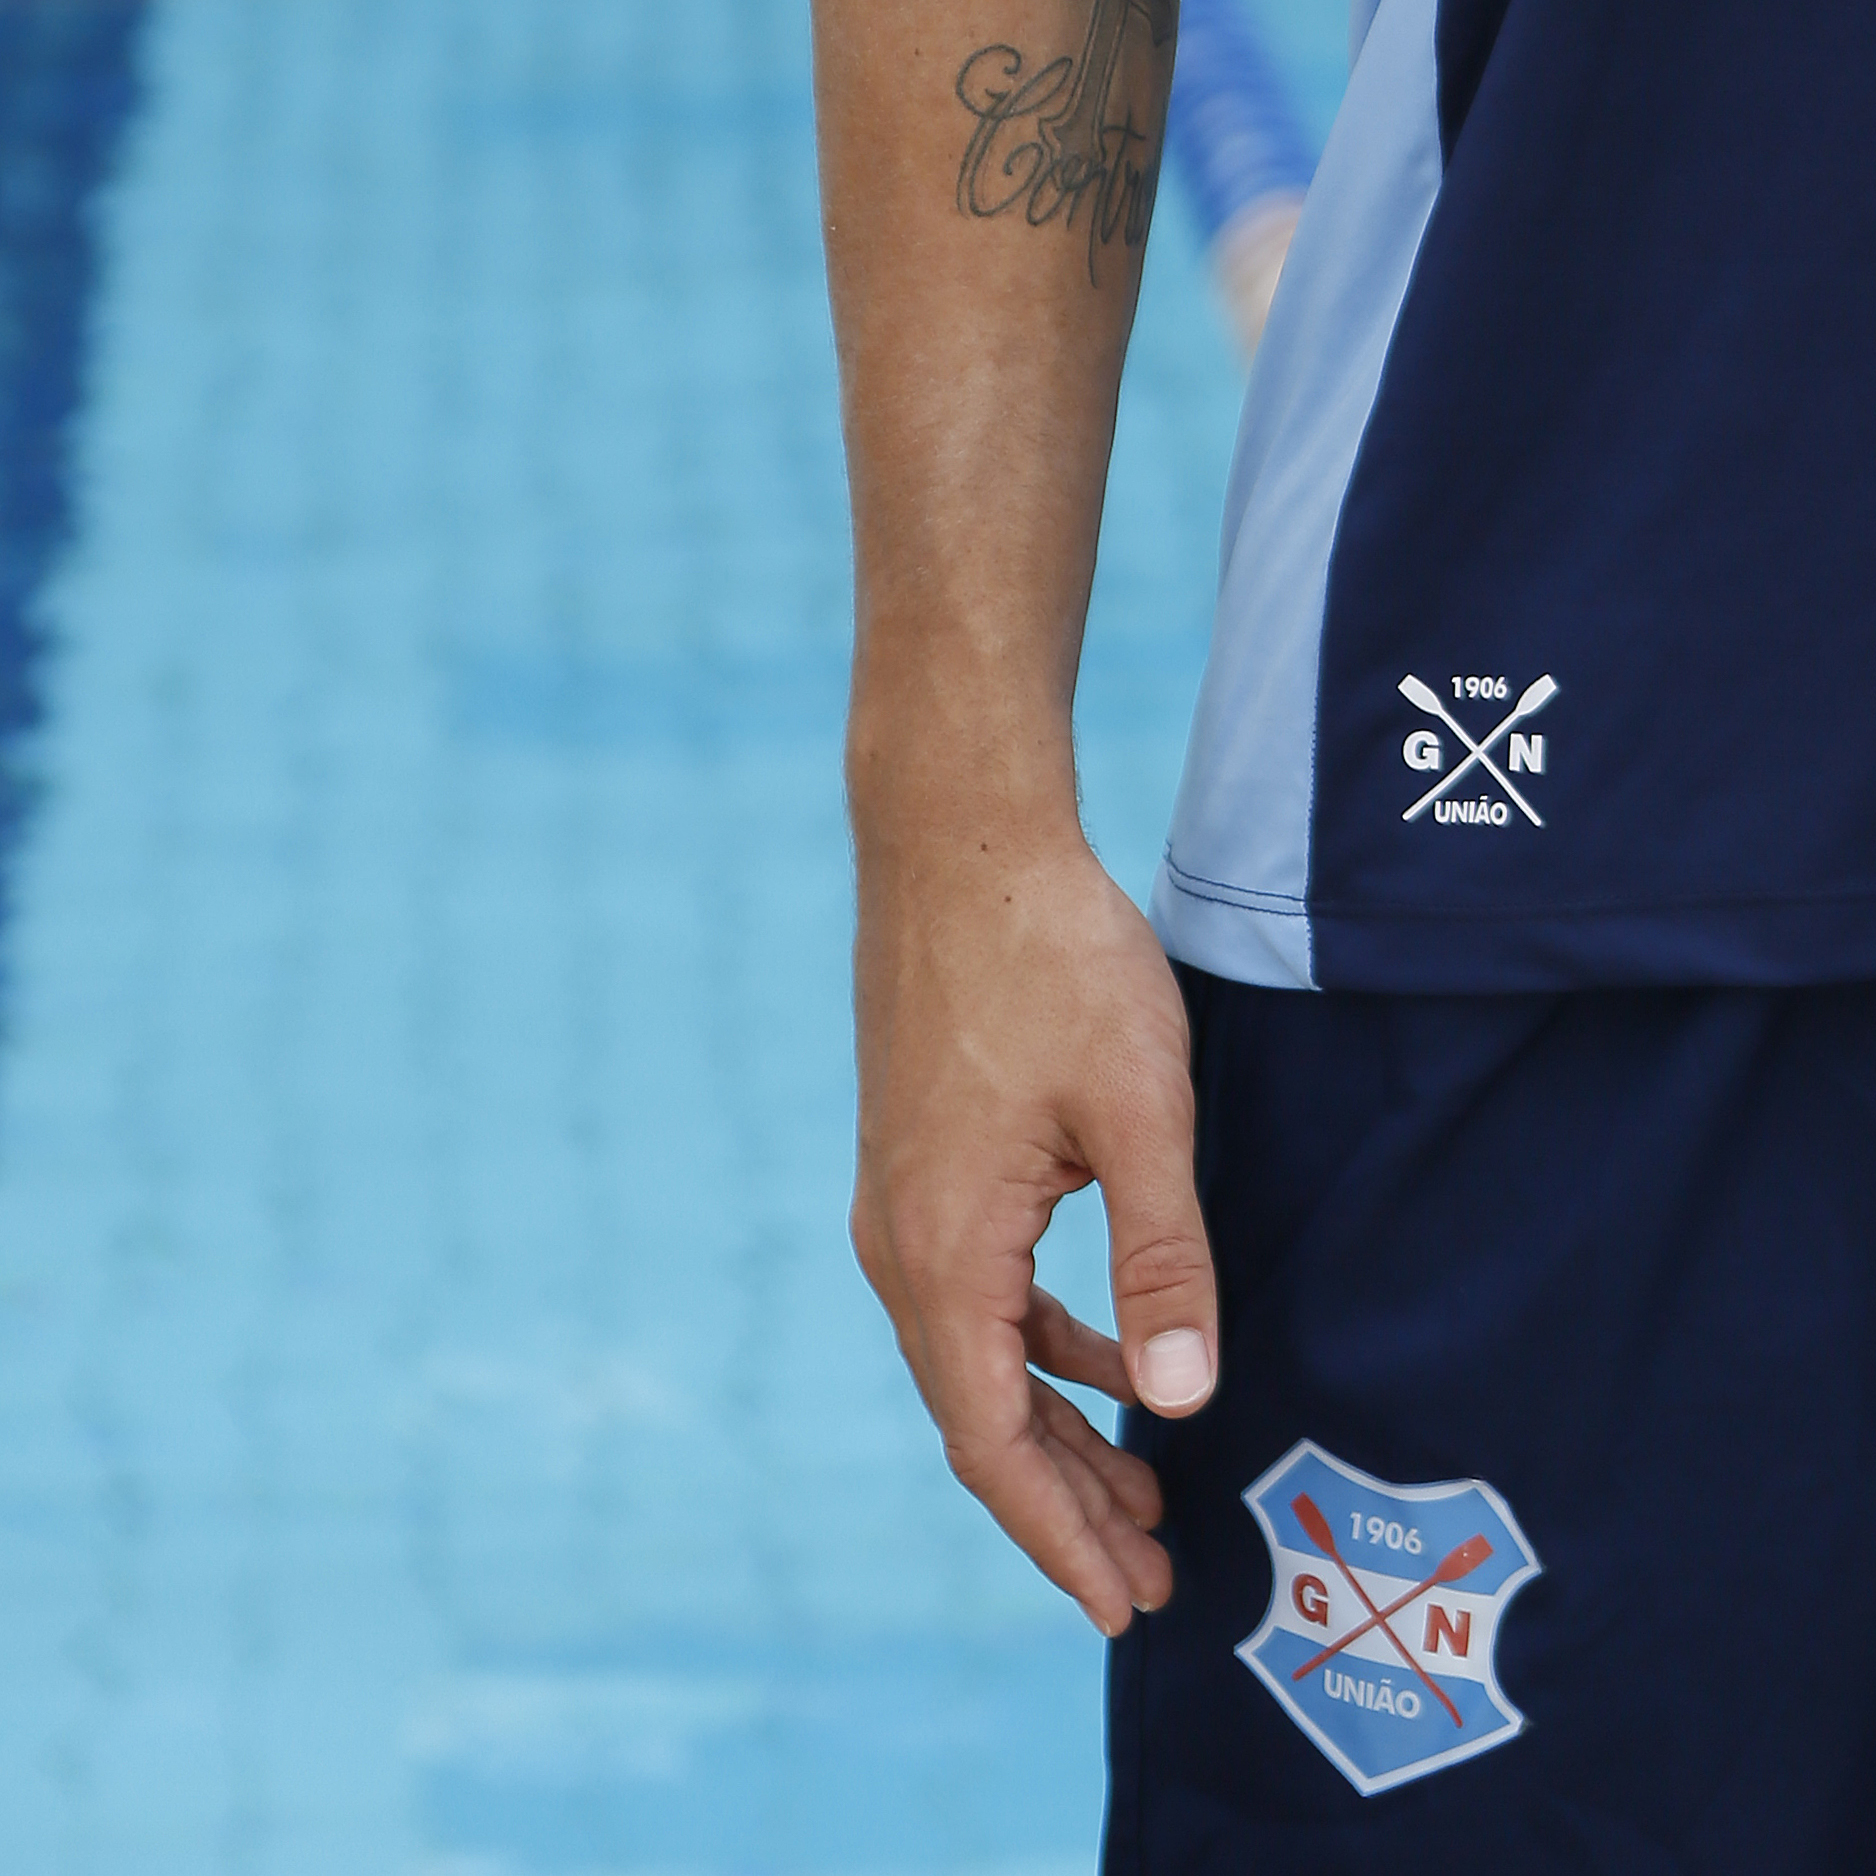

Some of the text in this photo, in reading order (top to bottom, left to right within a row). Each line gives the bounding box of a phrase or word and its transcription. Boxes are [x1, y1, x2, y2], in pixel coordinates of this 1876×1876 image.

[1451, 675, 1508, 700] 1906
[1402, 730, 1543, 773] G N
[1433, 794, 1508, 826] UNIÃO
[1348, 1510, 1423, 1556] 1906
[1291, 1573, 1472, 1658] G N
[1322, 1668, 1421, 1720] UNIÃO
